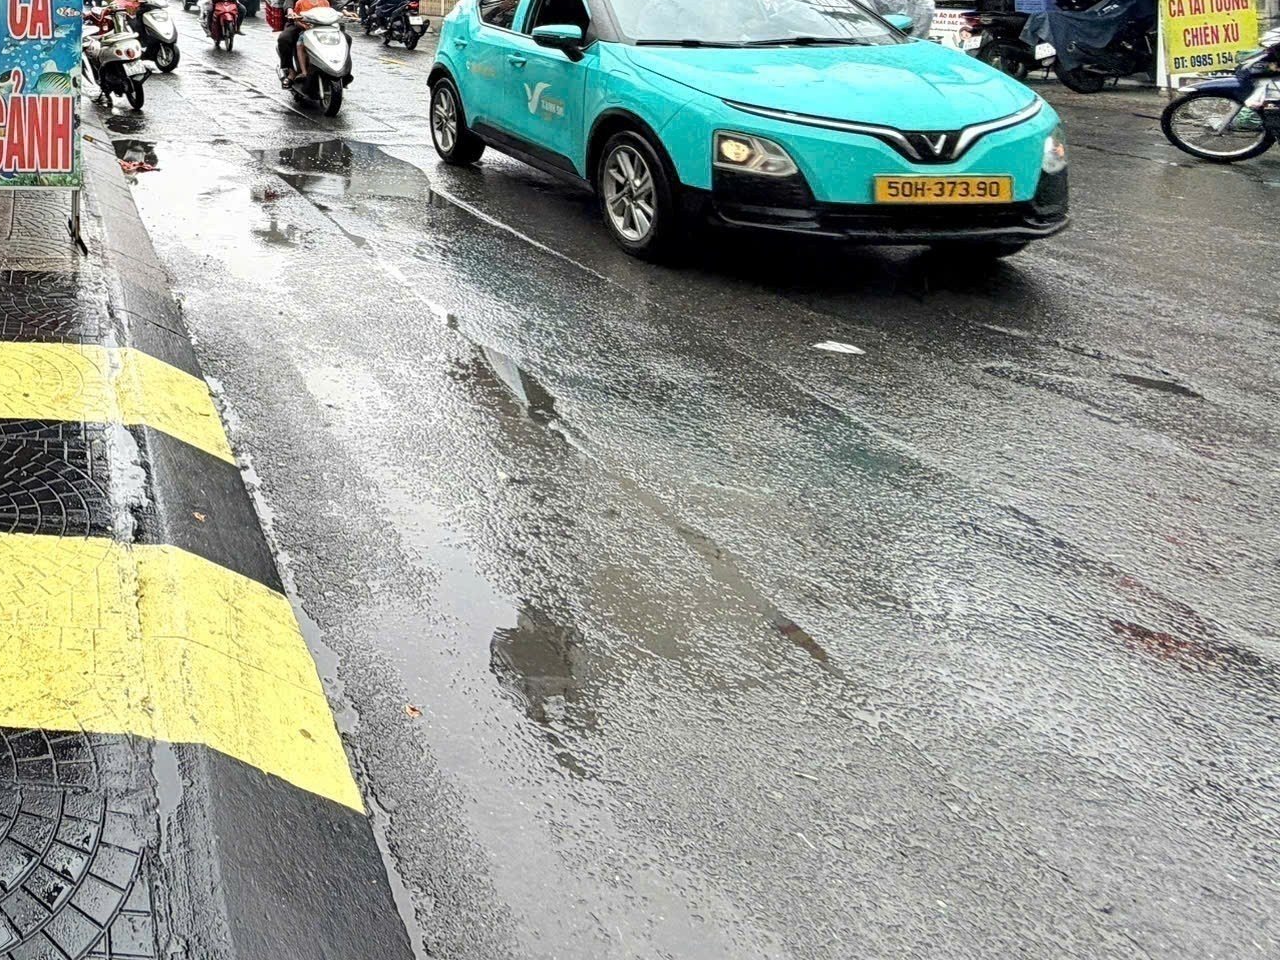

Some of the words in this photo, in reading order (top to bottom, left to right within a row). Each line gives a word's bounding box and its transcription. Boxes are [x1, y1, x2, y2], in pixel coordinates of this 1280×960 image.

[1183, 20, 1219, 48] CHIÊN
[1223, 18, 1240, 43] XÙ
[1174, 56, 1188, 69] ĐT:
[1190, 54, 1213, 68] 0985
[1216, 51, 1234, 65] 154
[887, 181, 1000, 198] 50H-373.90
